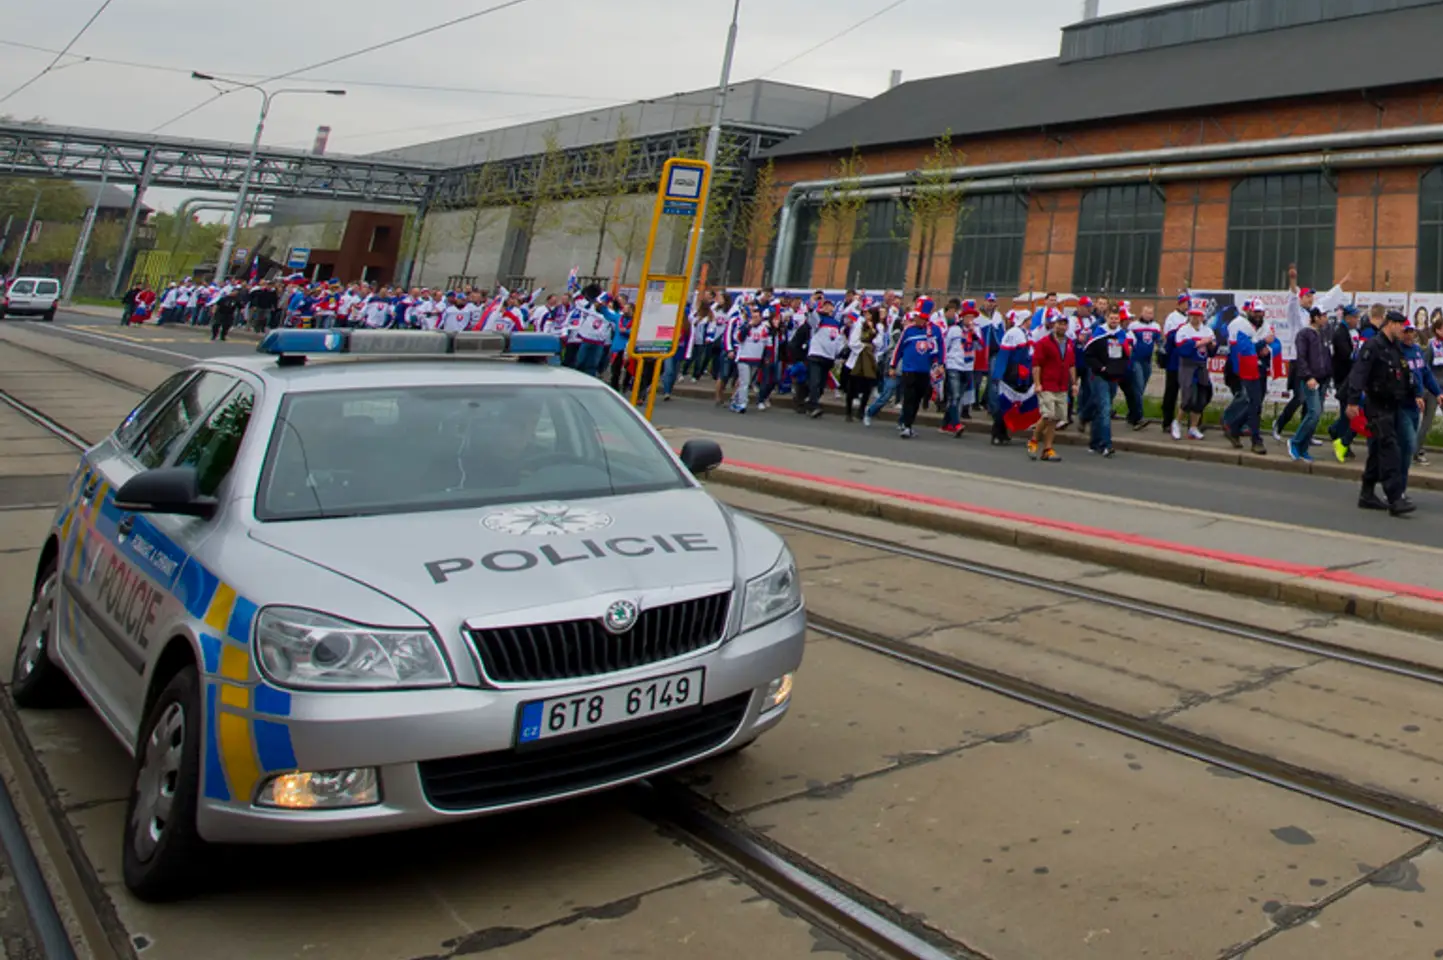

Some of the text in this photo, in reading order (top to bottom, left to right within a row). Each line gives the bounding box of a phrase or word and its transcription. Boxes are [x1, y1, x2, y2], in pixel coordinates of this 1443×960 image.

[424, 532, 719, 585] POLICIE
[97, 553, 164, 650] POLICIE
[549, 677, 690, 731] 6T8 6149
[522, 726, 539, 738] CZ
